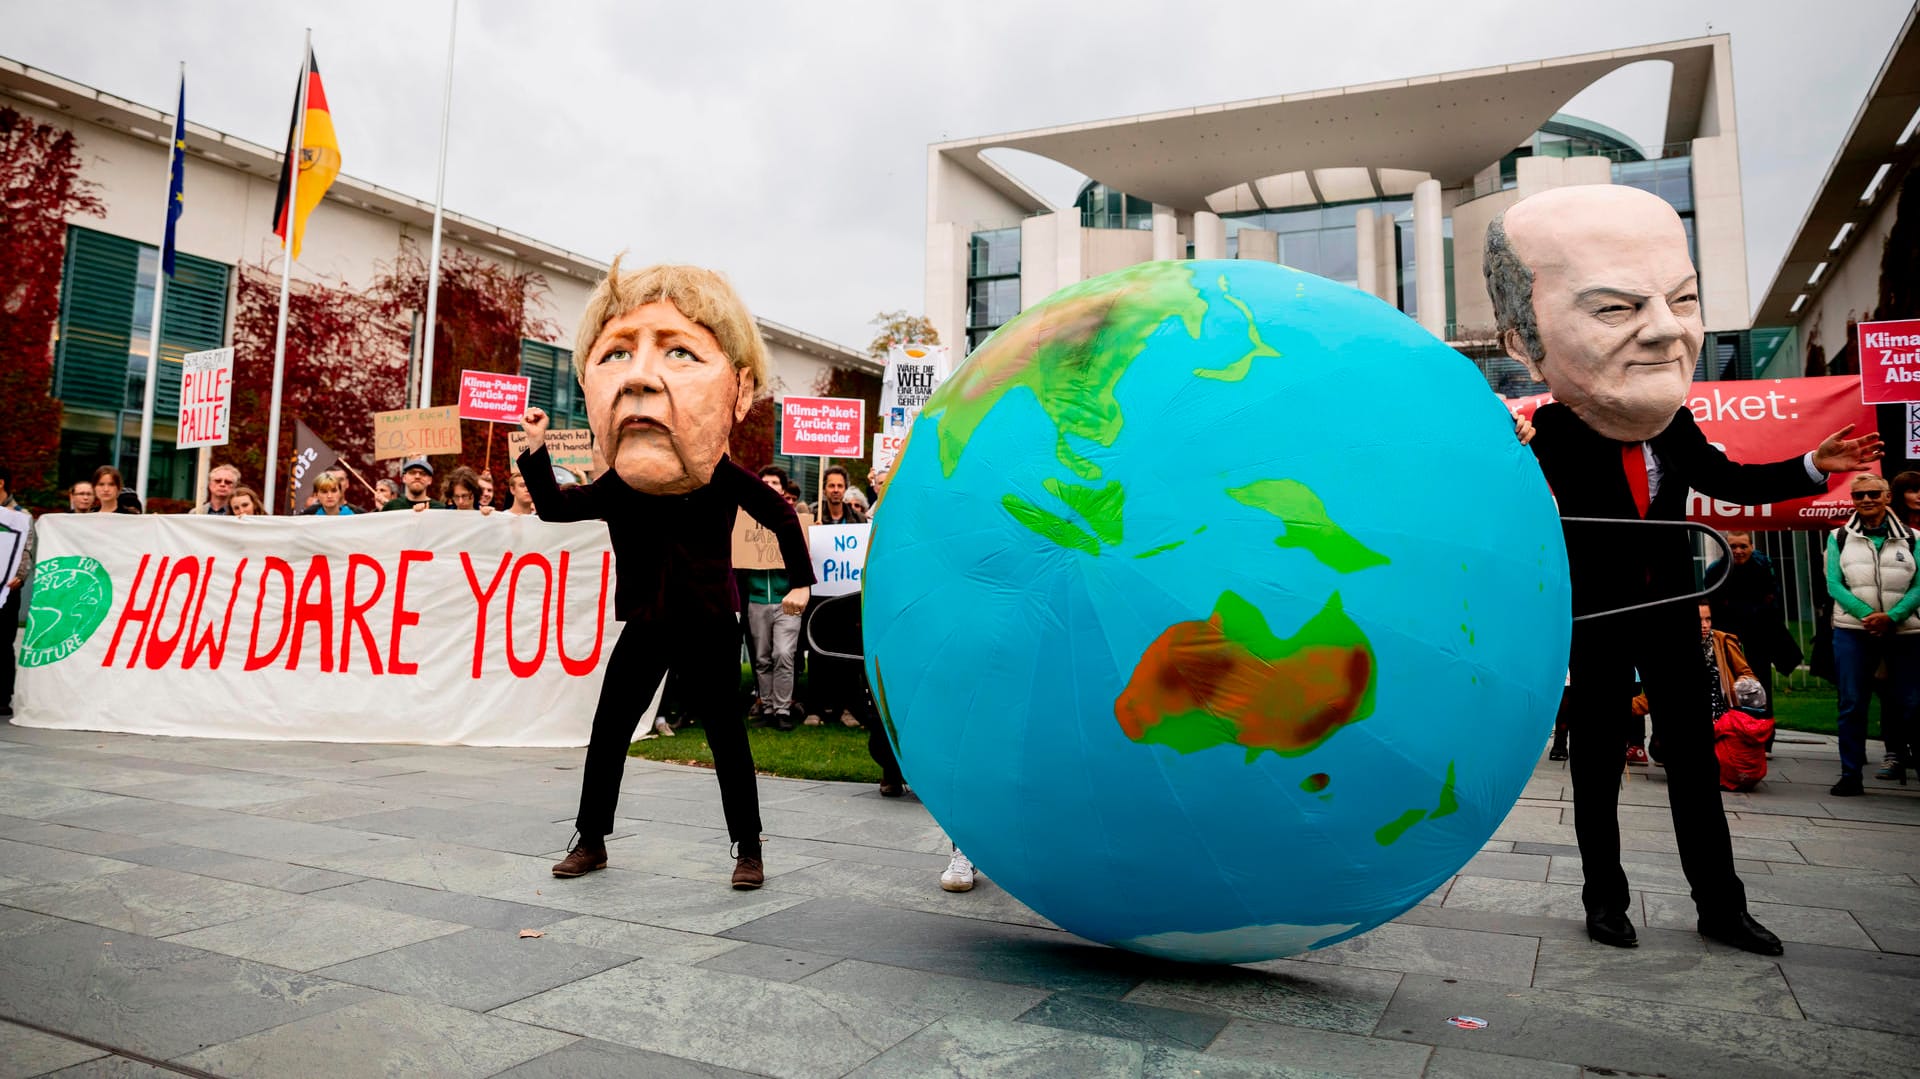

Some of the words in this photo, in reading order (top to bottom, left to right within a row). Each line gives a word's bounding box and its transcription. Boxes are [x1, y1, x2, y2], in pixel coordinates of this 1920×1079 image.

[922, 364, 934, 373] DIE
[184, 368, 230, 405] PILLE-
[464, 377, 525, 392] Klima-Paket:
[898, 373, 934, 388] WELT
[469, 388, 503, 400] Zurück
[505, 393, 518, 402] an
[915, 387, 932, 395] BANK
[470, 398, 517, 412] Absender
[786, 403, 858, 419] Klima-Paket:
[1683, 389, 1799, 422] aket:
[181, 404, 227, 443] PALLE!
[381, 413, 411, 423] TRAUT
[793, 417, 833, 430] Zurück
[836, 422, 850, 431] an
[406, 427, 460, 449] STEUER
[544, 431, 573, 441] anden
[575, 430, 588, 440] hat
[795, 430, 850, 443] Absender
[547, 443, 561, 451] cht
[835, 534, 857, 552] NO
[77, 557, 100, 572] FOR
[102, 553, 249, 671] HOW
[244, 549, 434, 675] DARE
[460, 550, 611, 679] YOU
[22, 633, 84, 666] FUTURE
